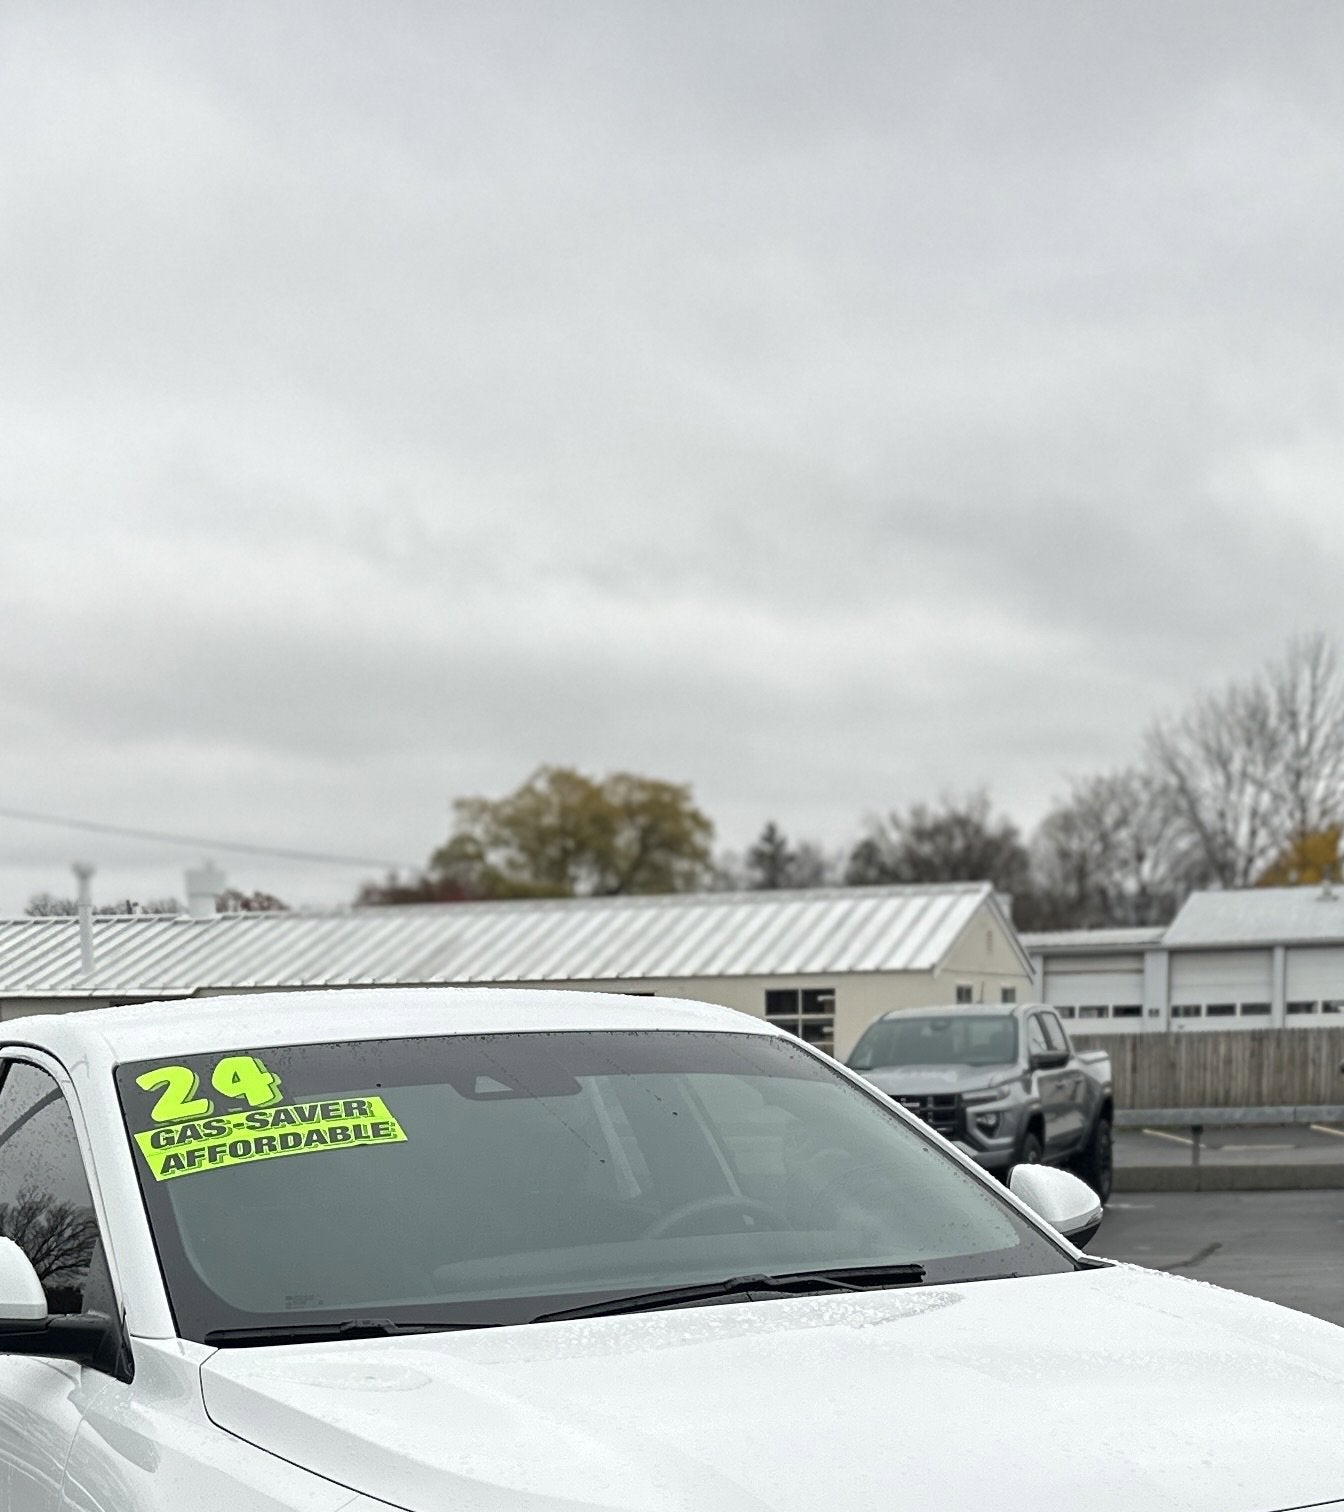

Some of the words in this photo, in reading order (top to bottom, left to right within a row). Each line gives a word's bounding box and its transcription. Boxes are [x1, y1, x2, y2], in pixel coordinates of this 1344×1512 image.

[135, 1056, 282, 1122] 24
[149, 1098, 374, 1151] GAS-SAVER
[159, 1120, 397, 1176] AFFORDABLE
